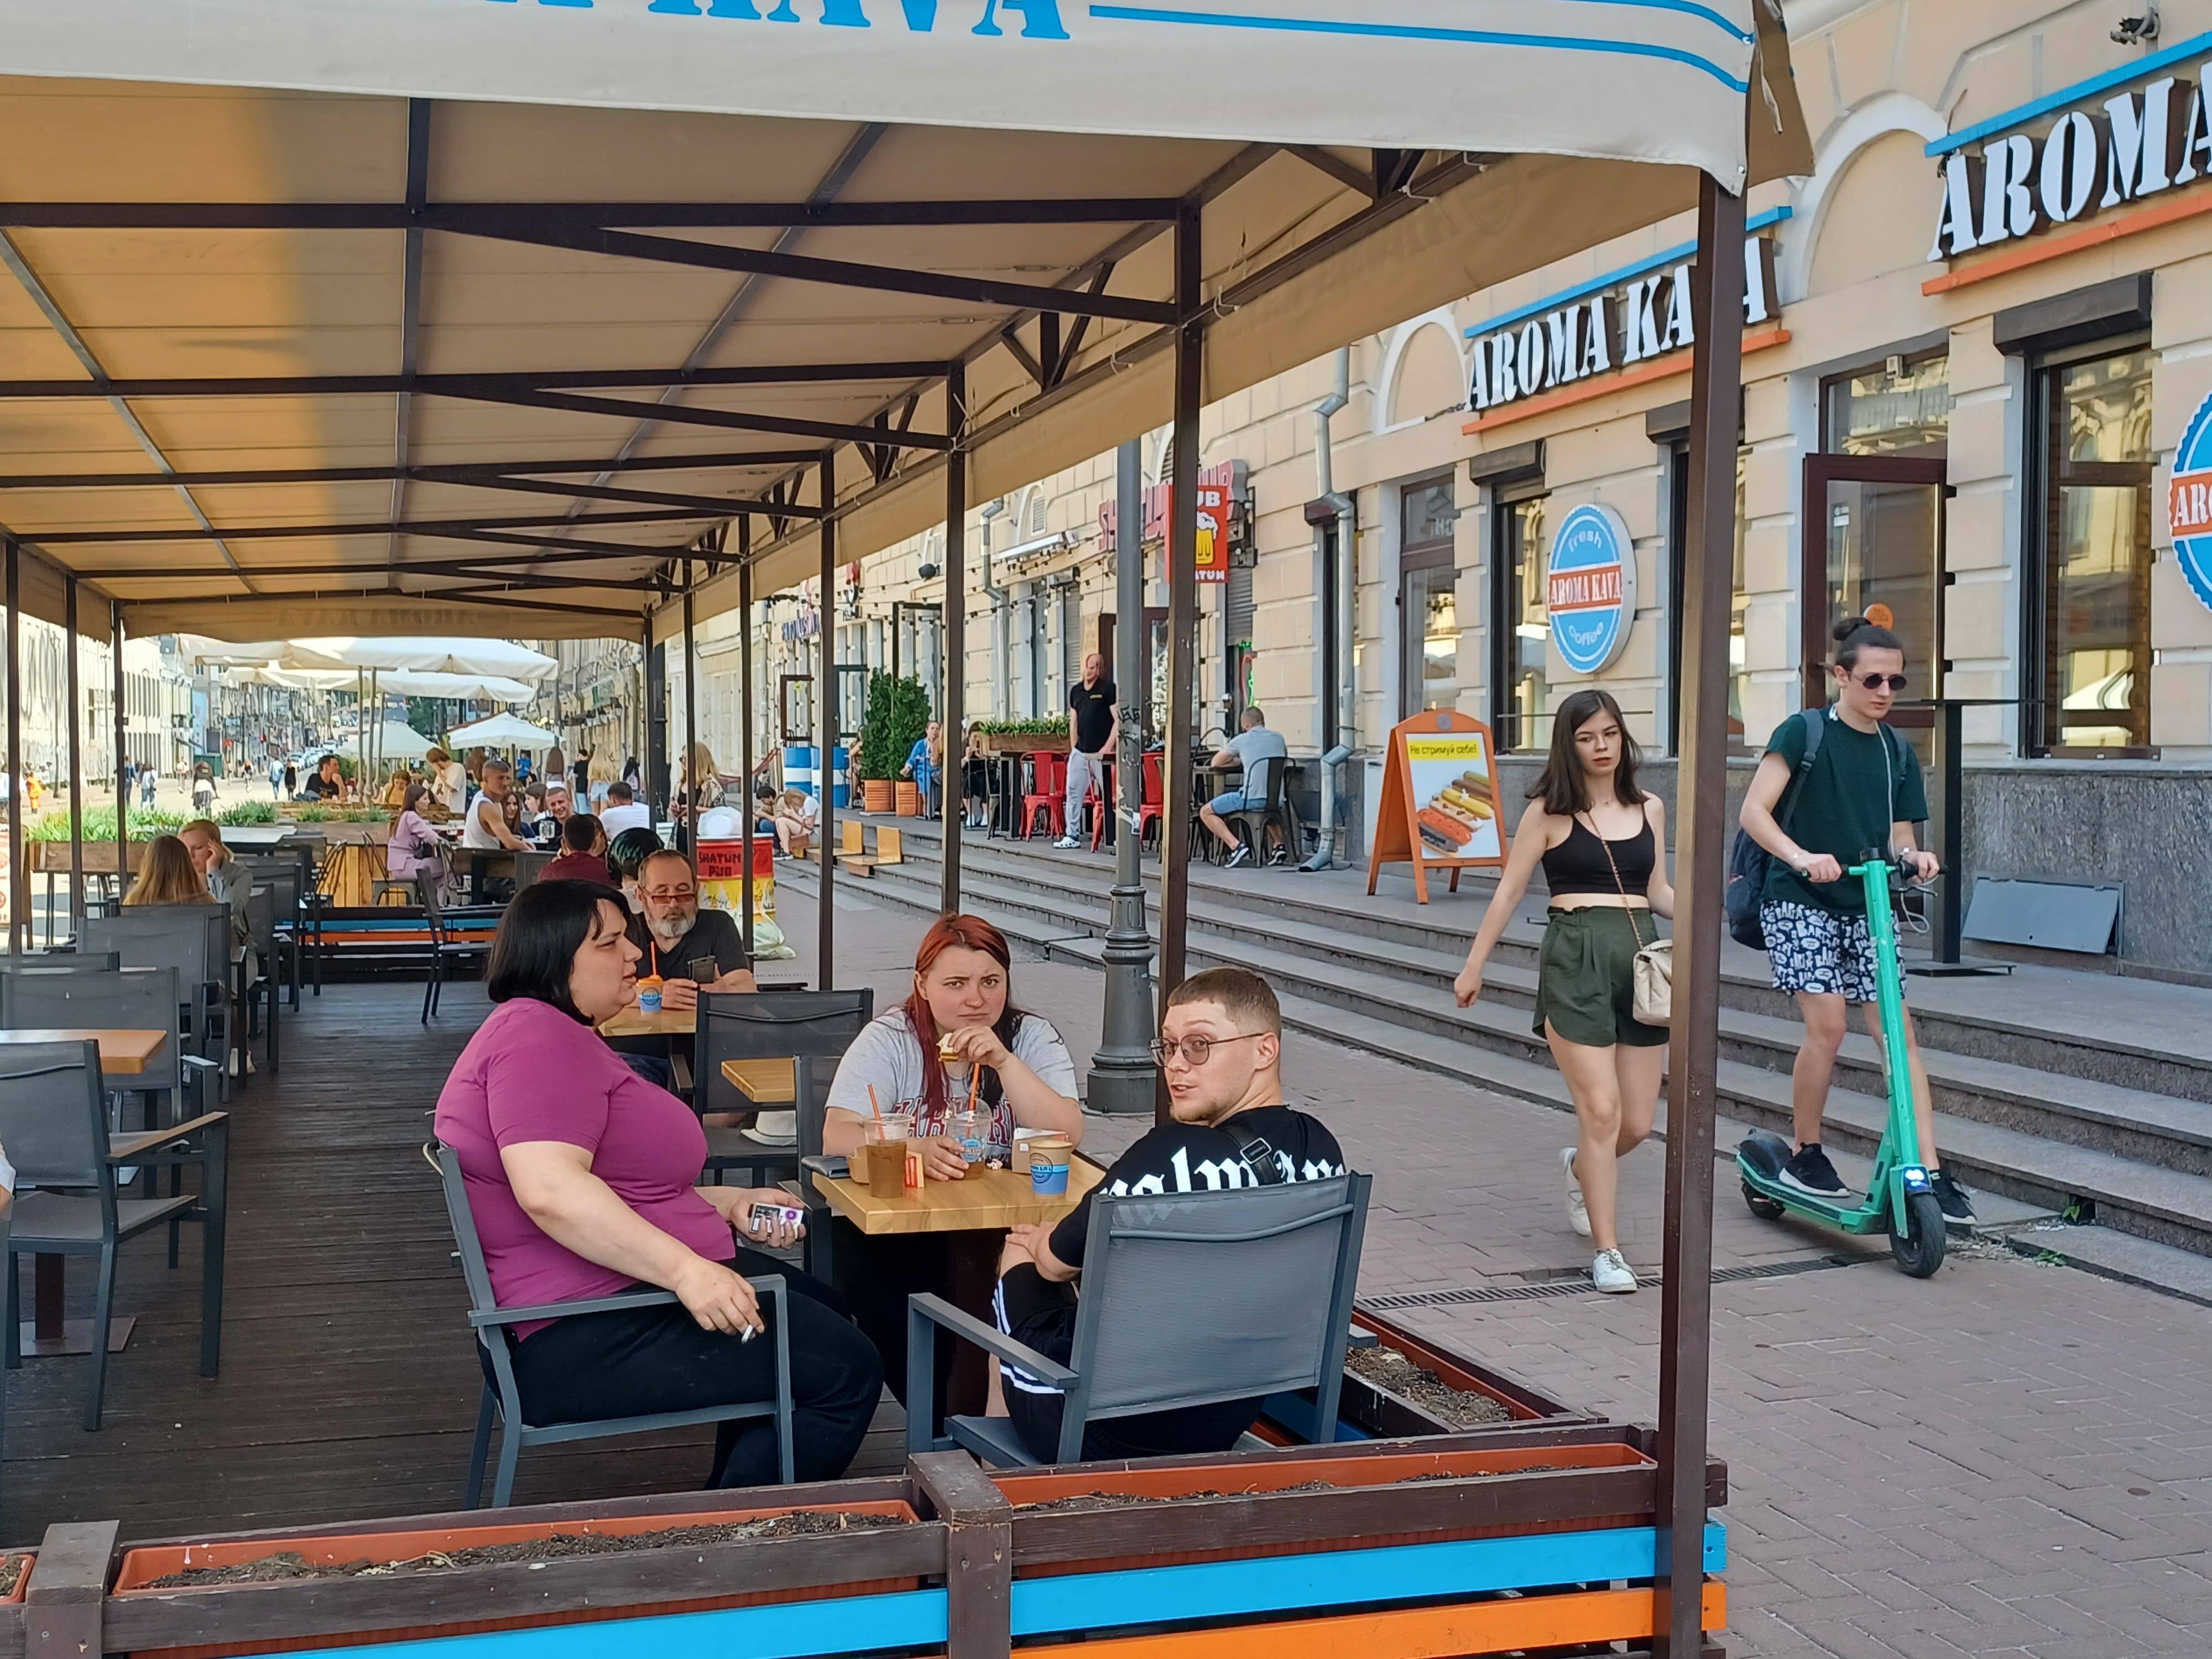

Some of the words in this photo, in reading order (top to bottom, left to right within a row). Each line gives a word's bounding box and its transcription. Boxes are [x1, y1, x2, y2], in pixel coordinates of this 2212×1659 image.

[1464, 295, 1611, 413] AROMA
[1621, 236, 1768, 365] KAA
[1550, 575, 1590, 606] AROMA
[1592, 570, 1621, 602] KAVA
[699, 852, 742, 864] SHATUN
